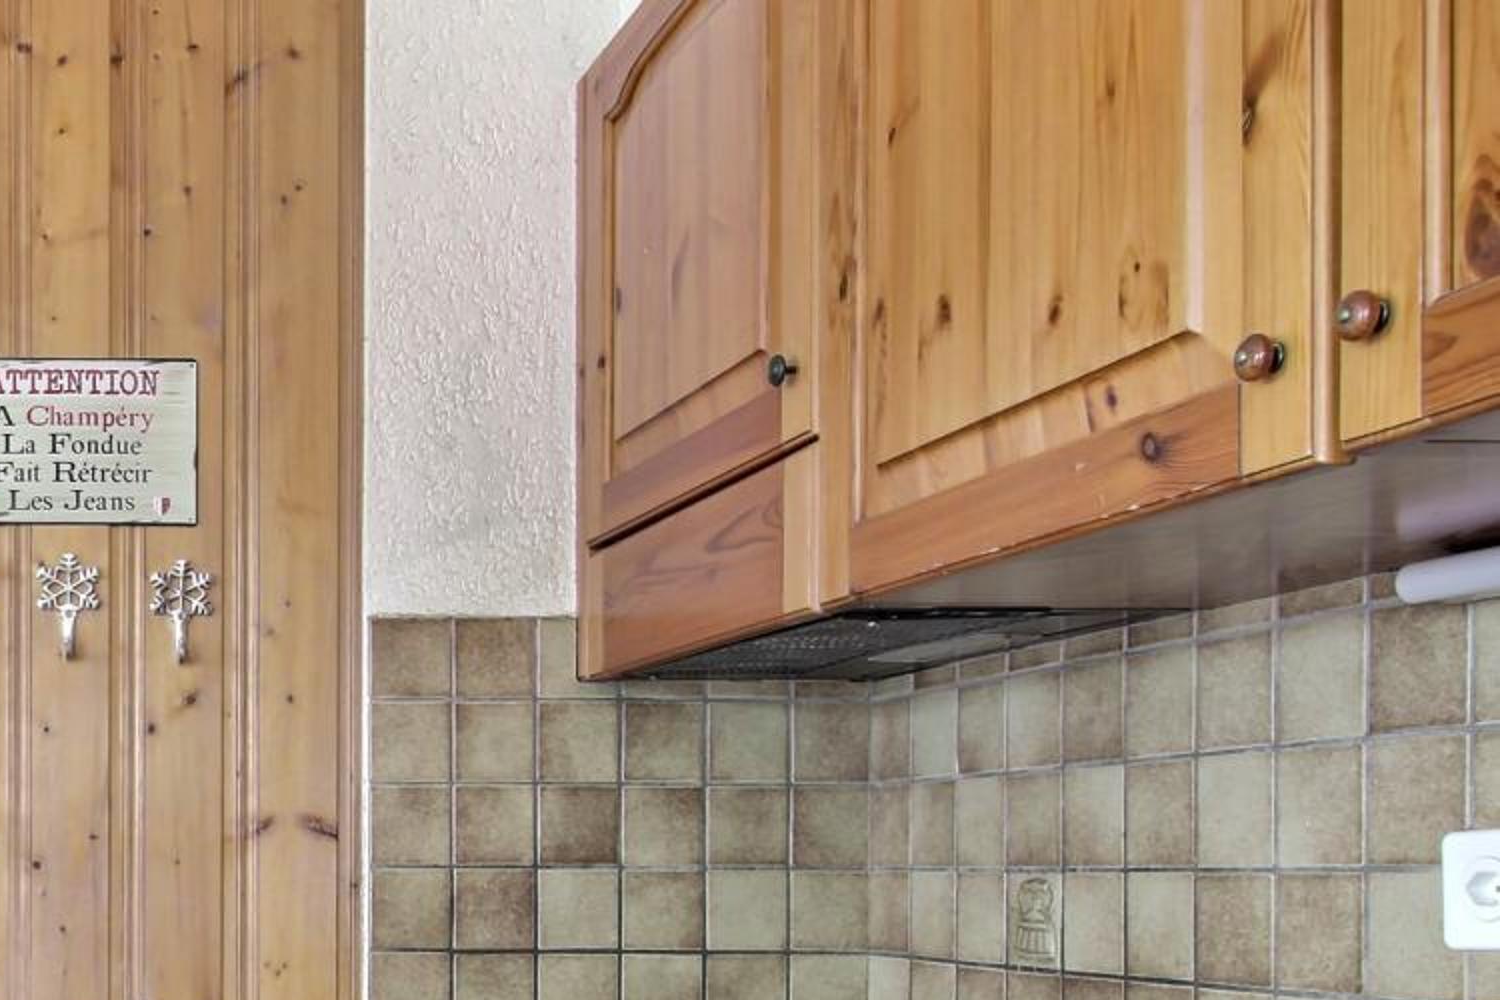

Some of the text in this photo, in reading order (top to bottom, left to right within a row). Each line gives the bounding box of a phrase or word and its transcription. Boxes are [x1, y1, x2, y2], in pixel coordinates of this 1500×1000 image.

[26, 405, 155, 433] Champéry
[1, 433, 143, 454] La Fondue
[52, 461, 153, 483] Rétrécir
[8, 489, 135, 511] Les Jeans
